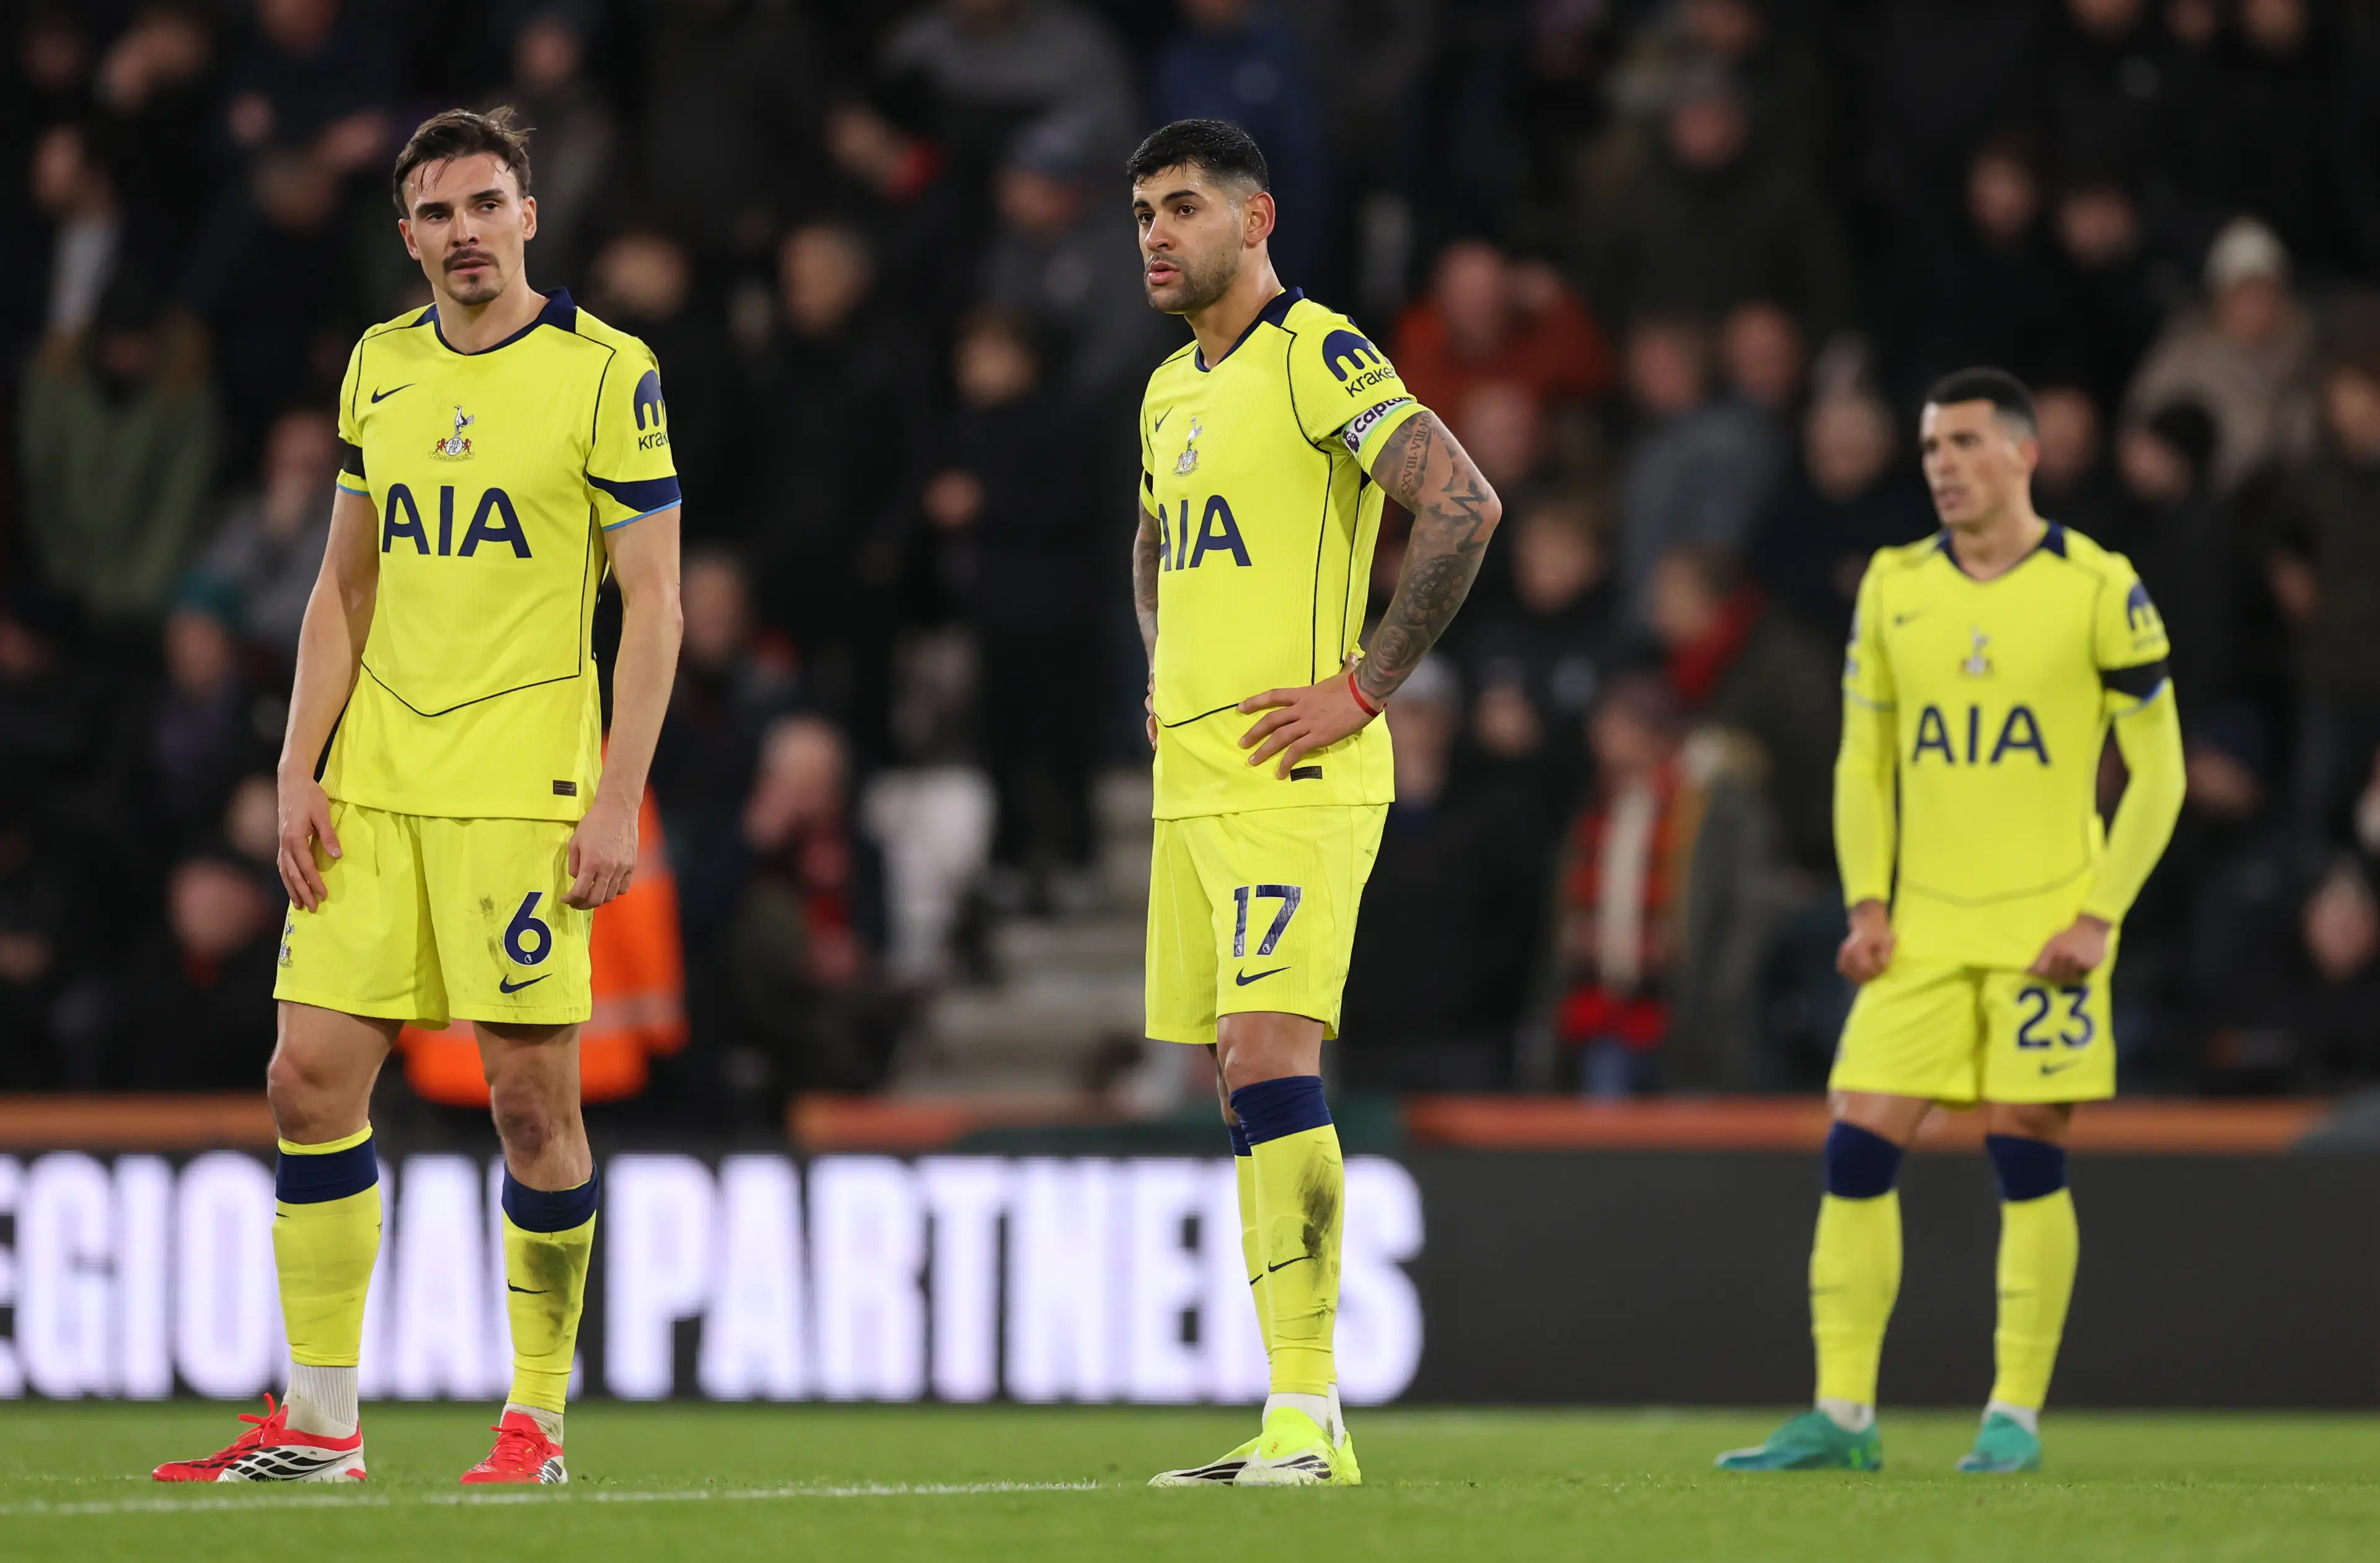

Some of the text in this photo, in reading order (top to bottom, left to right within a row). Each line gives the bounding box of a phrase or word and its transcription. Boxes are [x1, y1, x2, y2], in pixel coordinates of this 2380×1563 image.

[381, 483, 533, 558] AIA
[1158, 494, 1253, 572] AIA
[1911, 704, 2052, 766] AIA
[503, 891, 553, 967] 6
[1232, 883, 1302, 958] 17
[2016, 984, 2095, 1049] 23
